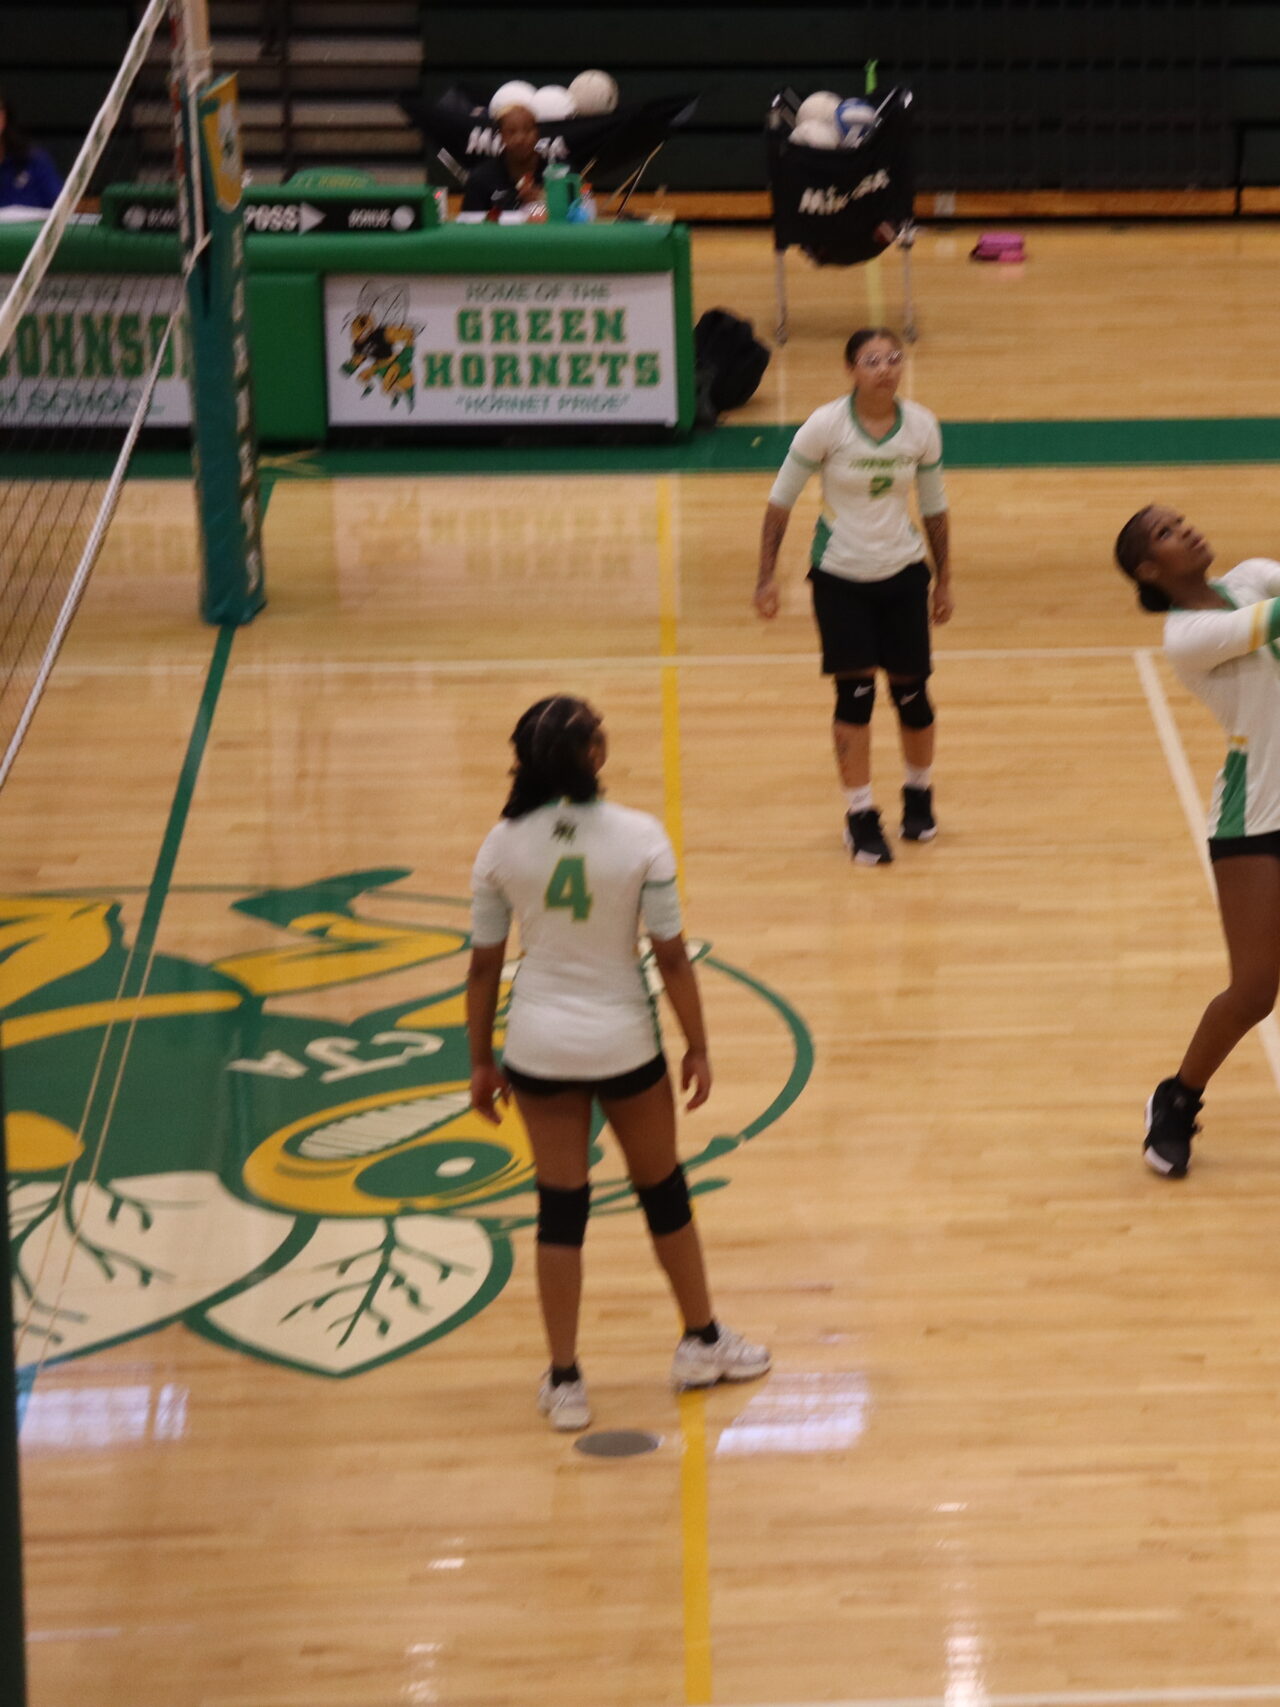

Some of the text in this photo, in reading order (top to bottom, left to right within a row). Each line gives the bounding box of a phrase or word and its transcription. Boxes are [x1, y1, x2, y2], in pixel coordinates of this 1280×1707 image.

[466, 282, 612, 301] HOME OF THE
[455, 306, 627, 344] GREEN
[0, 313, 190, 379] OHNSO
[423, 351, 662, 389] HORNETS
[543, 853, 593, 923] 4
